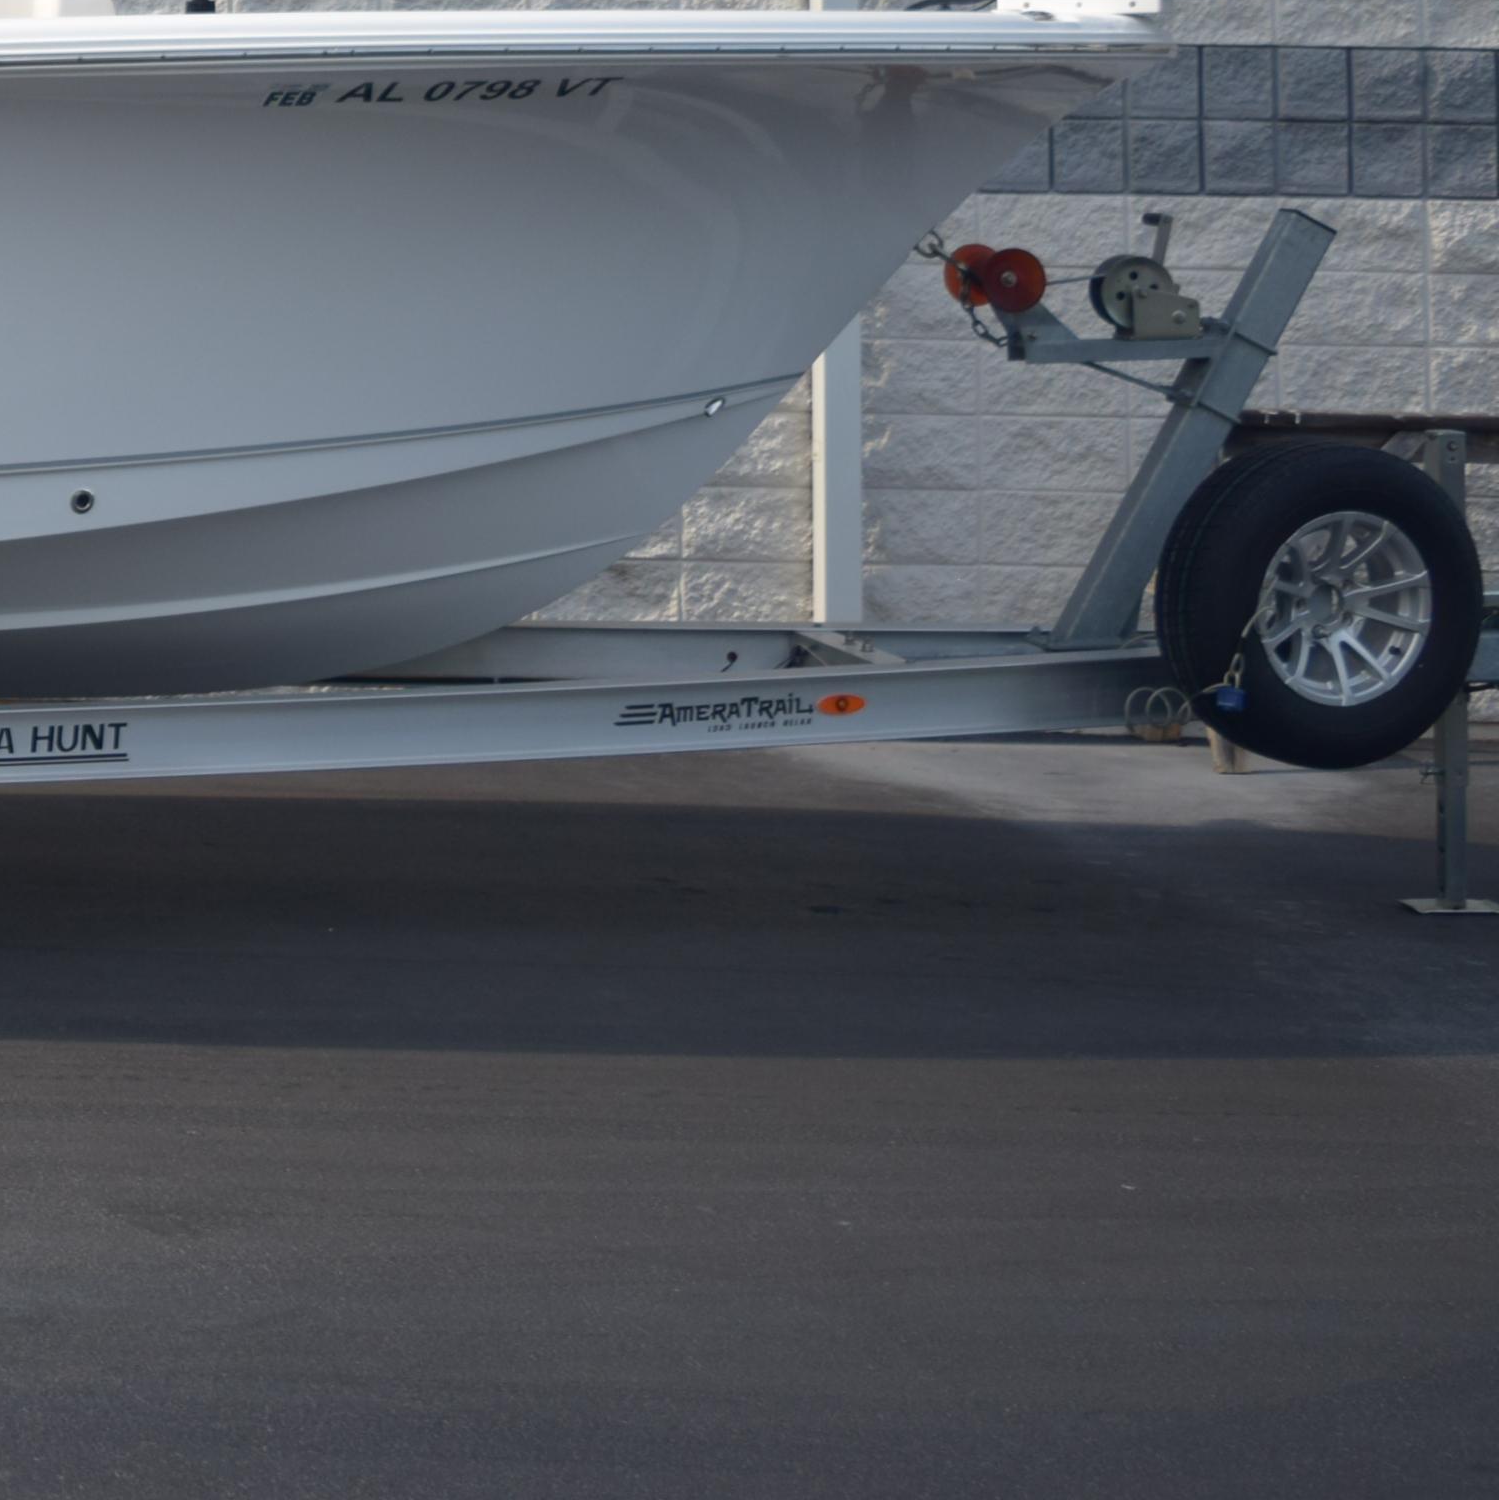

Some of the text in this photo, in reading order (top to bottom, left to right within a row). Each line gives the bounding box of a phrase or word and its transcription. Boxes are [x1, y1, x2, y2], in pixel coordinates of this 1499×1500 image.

[262, 91, 317, 107] FEB
[336, 81, 404, 103] AL
[423, 79, 543, 102] 0798
[555, 77, 625, 98] VT
[30, 722, 128, 753] HUNT
